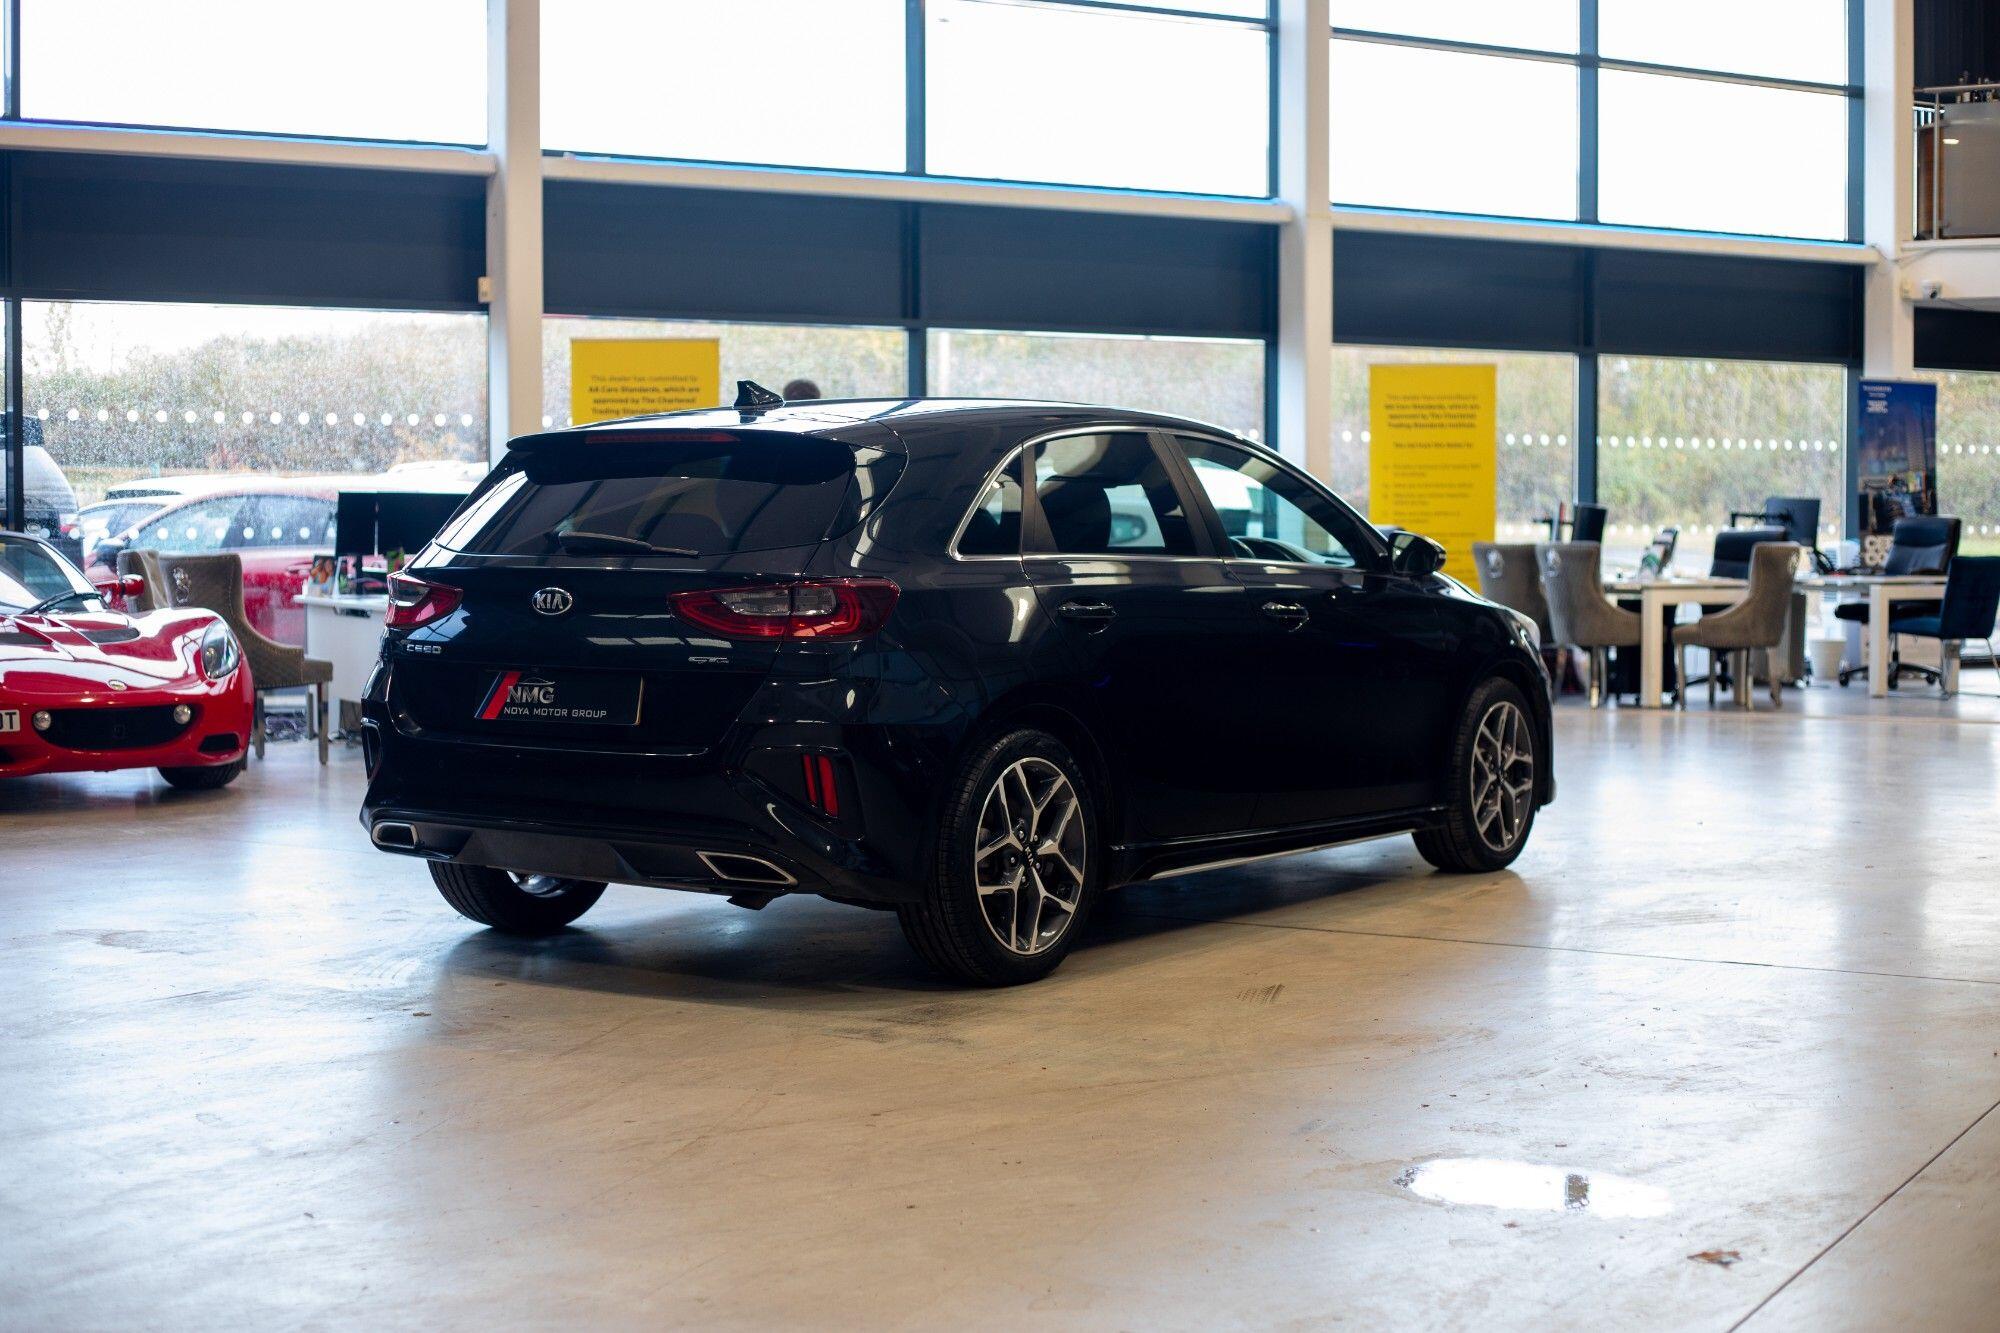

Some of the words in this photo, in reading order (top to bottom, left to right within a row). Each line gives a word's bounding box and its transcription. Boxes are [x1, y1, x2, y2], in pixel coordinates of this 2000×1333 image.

[536, 593, 564, 609] KIA
[406, 643, 442, 654] CEED
[506, 685, 555, 704] NMG
[503, 706, 530, 716] NOYA
[533, 707, 568, 717] MOTOR
[571, 709, 607, 718] GROUP
